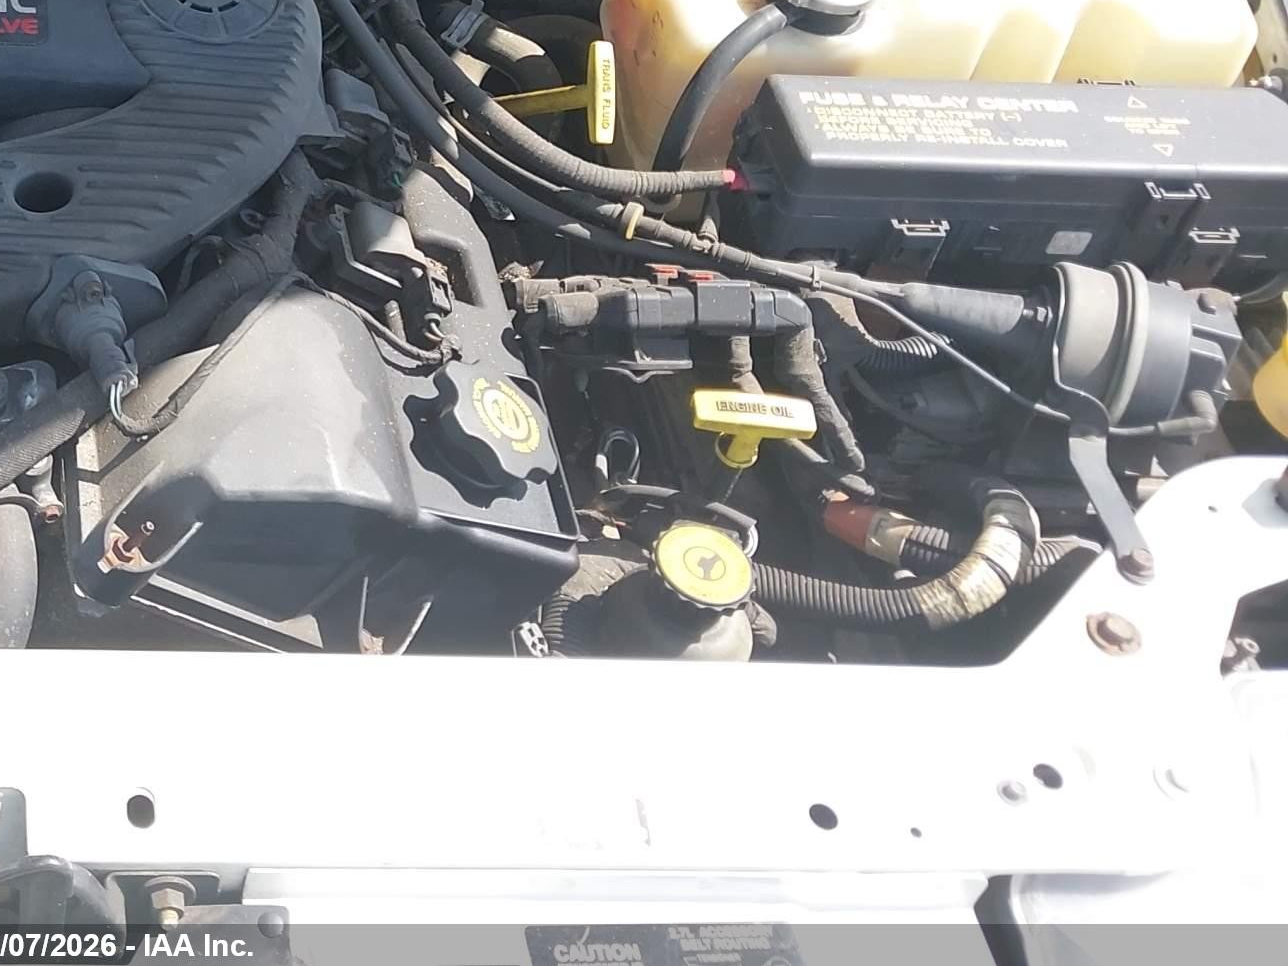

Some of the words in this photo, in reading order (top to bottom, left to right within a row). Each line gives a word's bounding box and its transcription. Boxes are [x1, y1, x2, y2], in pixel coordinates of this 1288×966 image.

[799, 91, 866, 105] FUSE
[891, 94, 969, 109] RELAY
[977, 97, 1079, 113] CENTER
[814, 106, 918, 118] DISCONNECT
[923, 109, 995, 121] BATTERY
[1012, 137, 1069, 148] COVER
[715, 400, 767, 415] ENGINE
[770, 405, 795, 419] OIL
[554, 943, 642, 963] CAUTION
